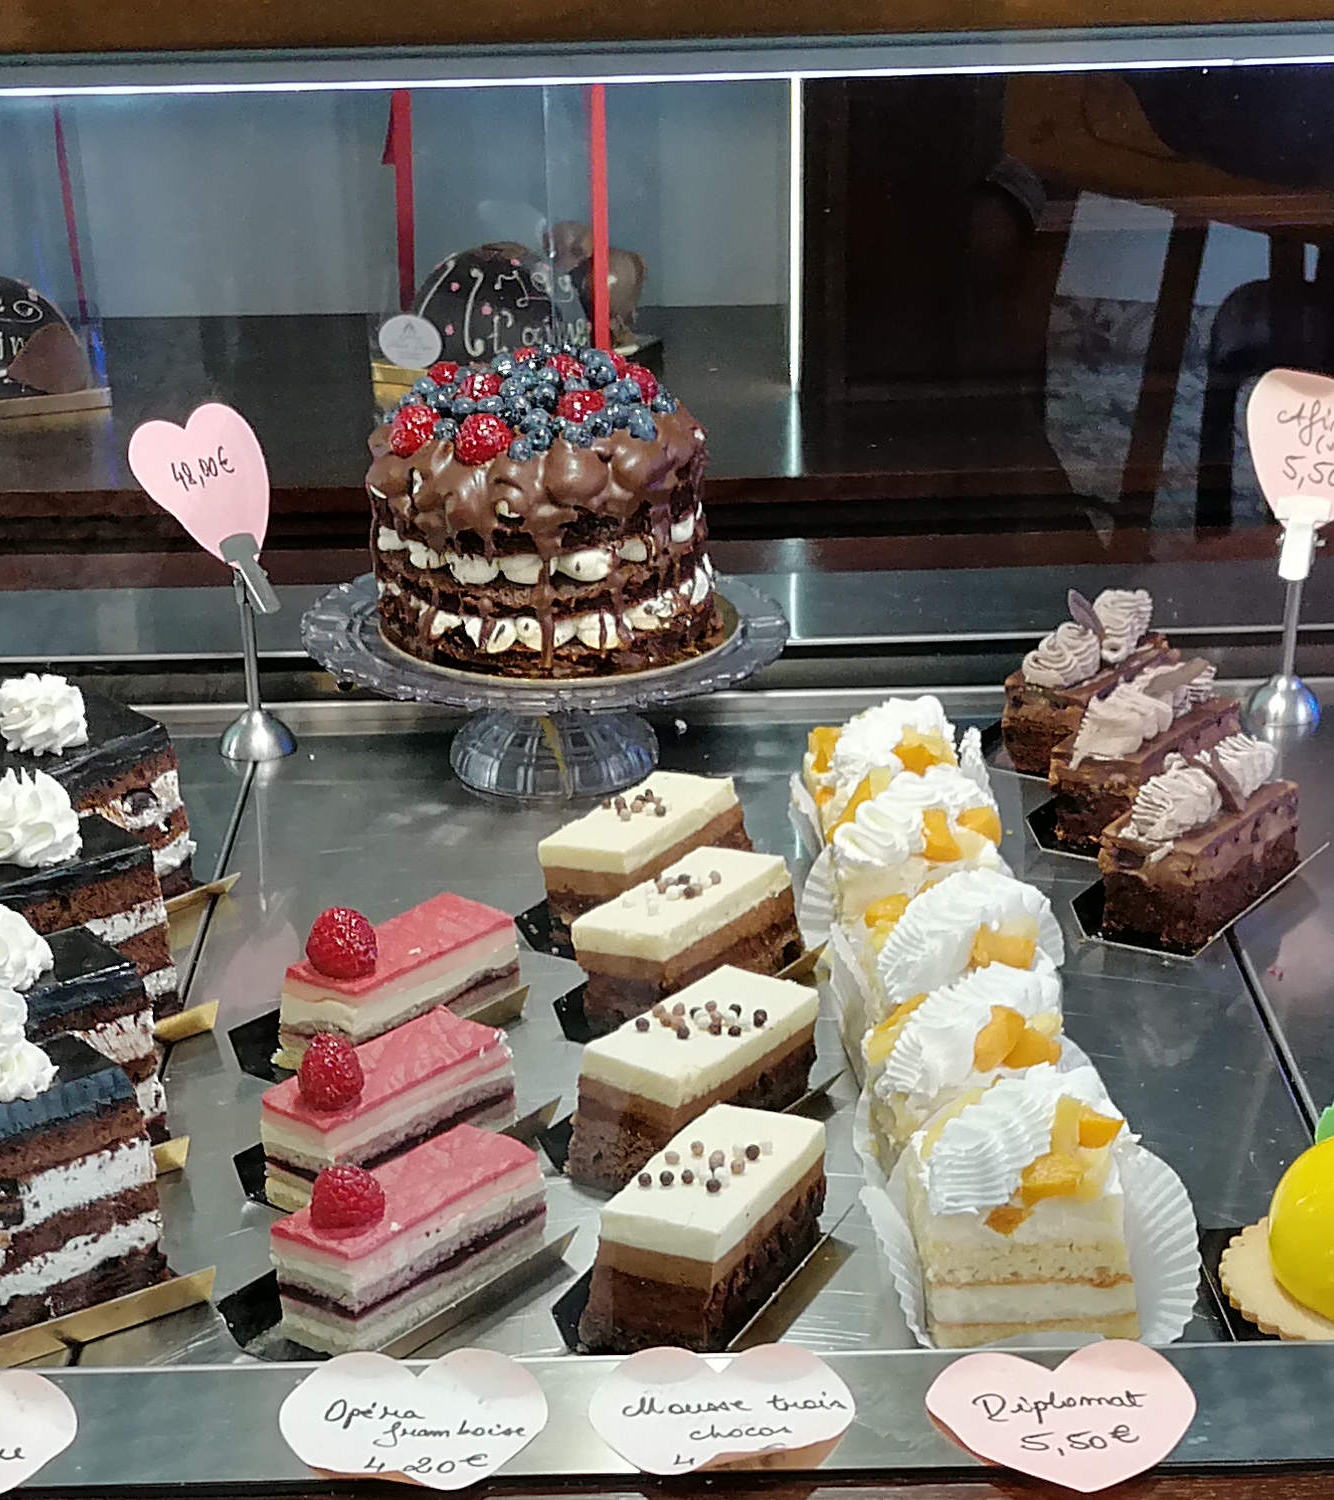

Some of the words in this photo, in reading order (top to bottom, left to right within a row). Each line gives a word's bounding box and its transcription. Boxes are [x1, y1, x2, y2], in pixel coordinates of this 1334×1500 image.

[323, 1399, 427, 1430] Opéra
[622, 1396, 753, 1418] Mousse
[767, 1391, 848, 1412] trois
[971, 1390, 1148, 1424] Diplomat
[1020, 1424, 1140, 1457] 5,50€
